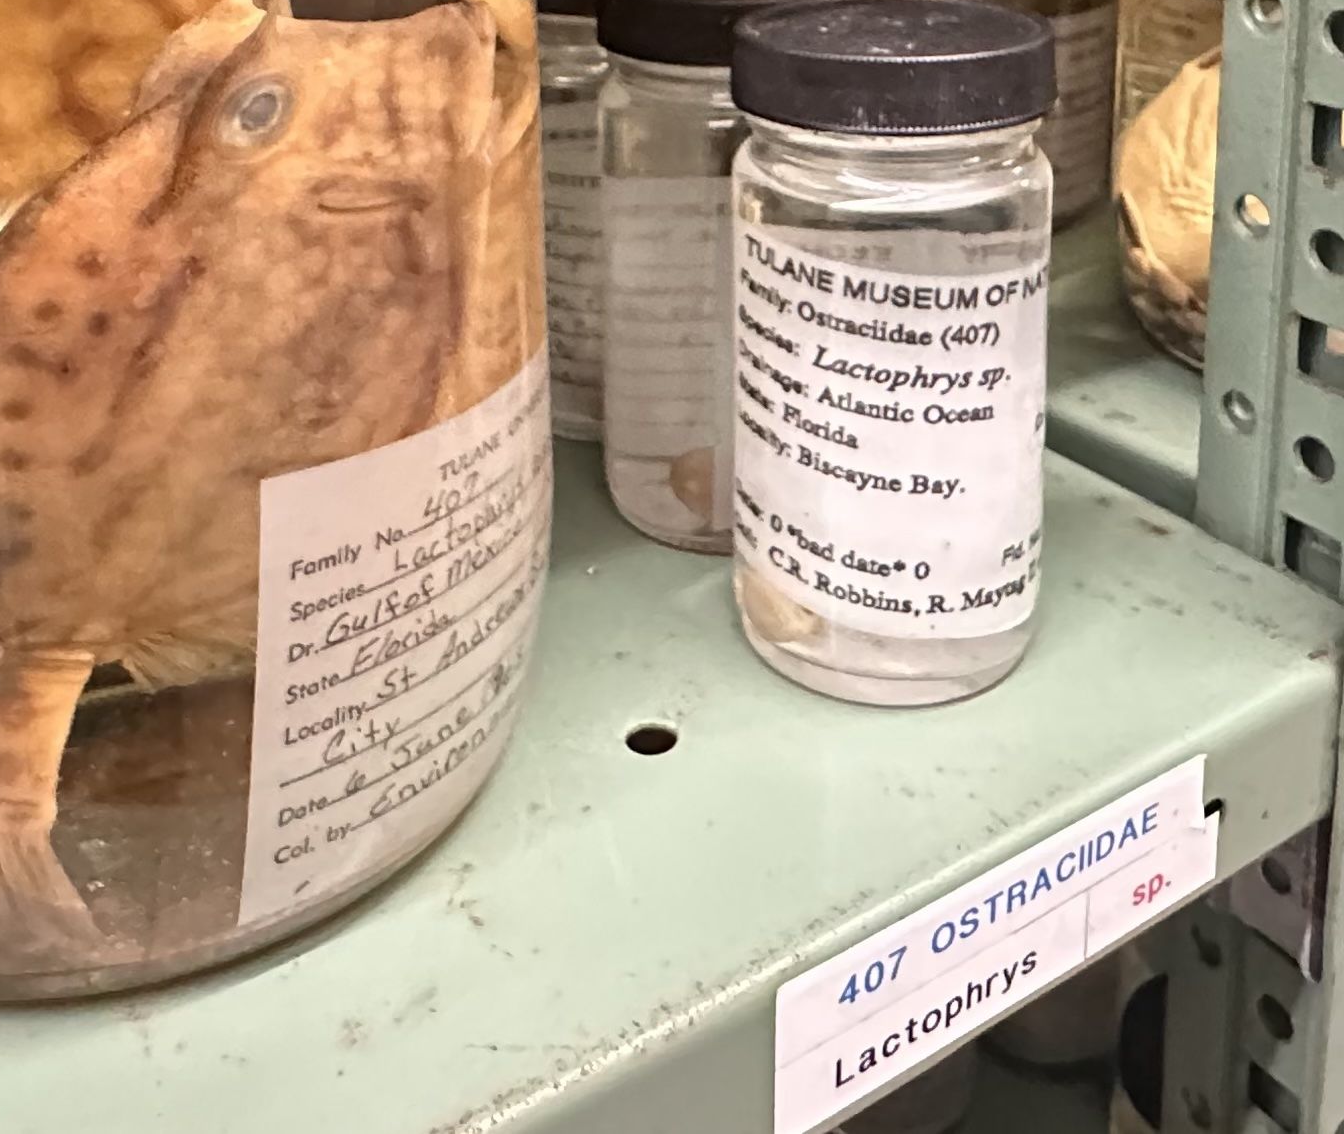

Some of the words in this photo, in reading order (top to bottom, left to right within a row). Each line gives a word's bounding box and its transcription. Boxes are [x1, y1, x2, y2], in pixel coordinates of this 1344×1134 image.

[744, 232, 835, 295] TULANE
[841, 274, 979, 311] MUSEUM
[984, 279, 1020, 308] OF
[796, 299, 934, 347] Ostraciidae
[939, 321, 1001, 352] (407)
[812, 343, 973, 395] Lactophrys
[976, 367, 1013, 390] sp.
[781, 401, 861, 450] Florida
[817, 385, 916, 424] Atlantic
[922, 403, 996, 426] Ocean
[796, 443, 904, 493] Biscayne
[907, 473, 967, 500] Bay.
[289, 541, 362, 582] Family
[423, 470, 480, 519] 407
[289, 582, 367, 624] Species
[812, 569, 921, 618] Robbins,
[287, 640, 320, 664] Dr.
[324, 589, 399, 646] Gulf
[285, 671, 344, 705] State
[284, 700, 368, 746] Locality
[321, 716, 401, 767] City
[277, 797, 328, 827] Date
[273, 835, 316, 865] Col.
[325, 823, 355, 843] by
[838, 945, 910, 1006] 407
[930, 801, 1161, 956] OSTRACIIDAE
[1130, 870, 1174, 907] sp.
[833, 949, 1040, 1089] Lactophrys
